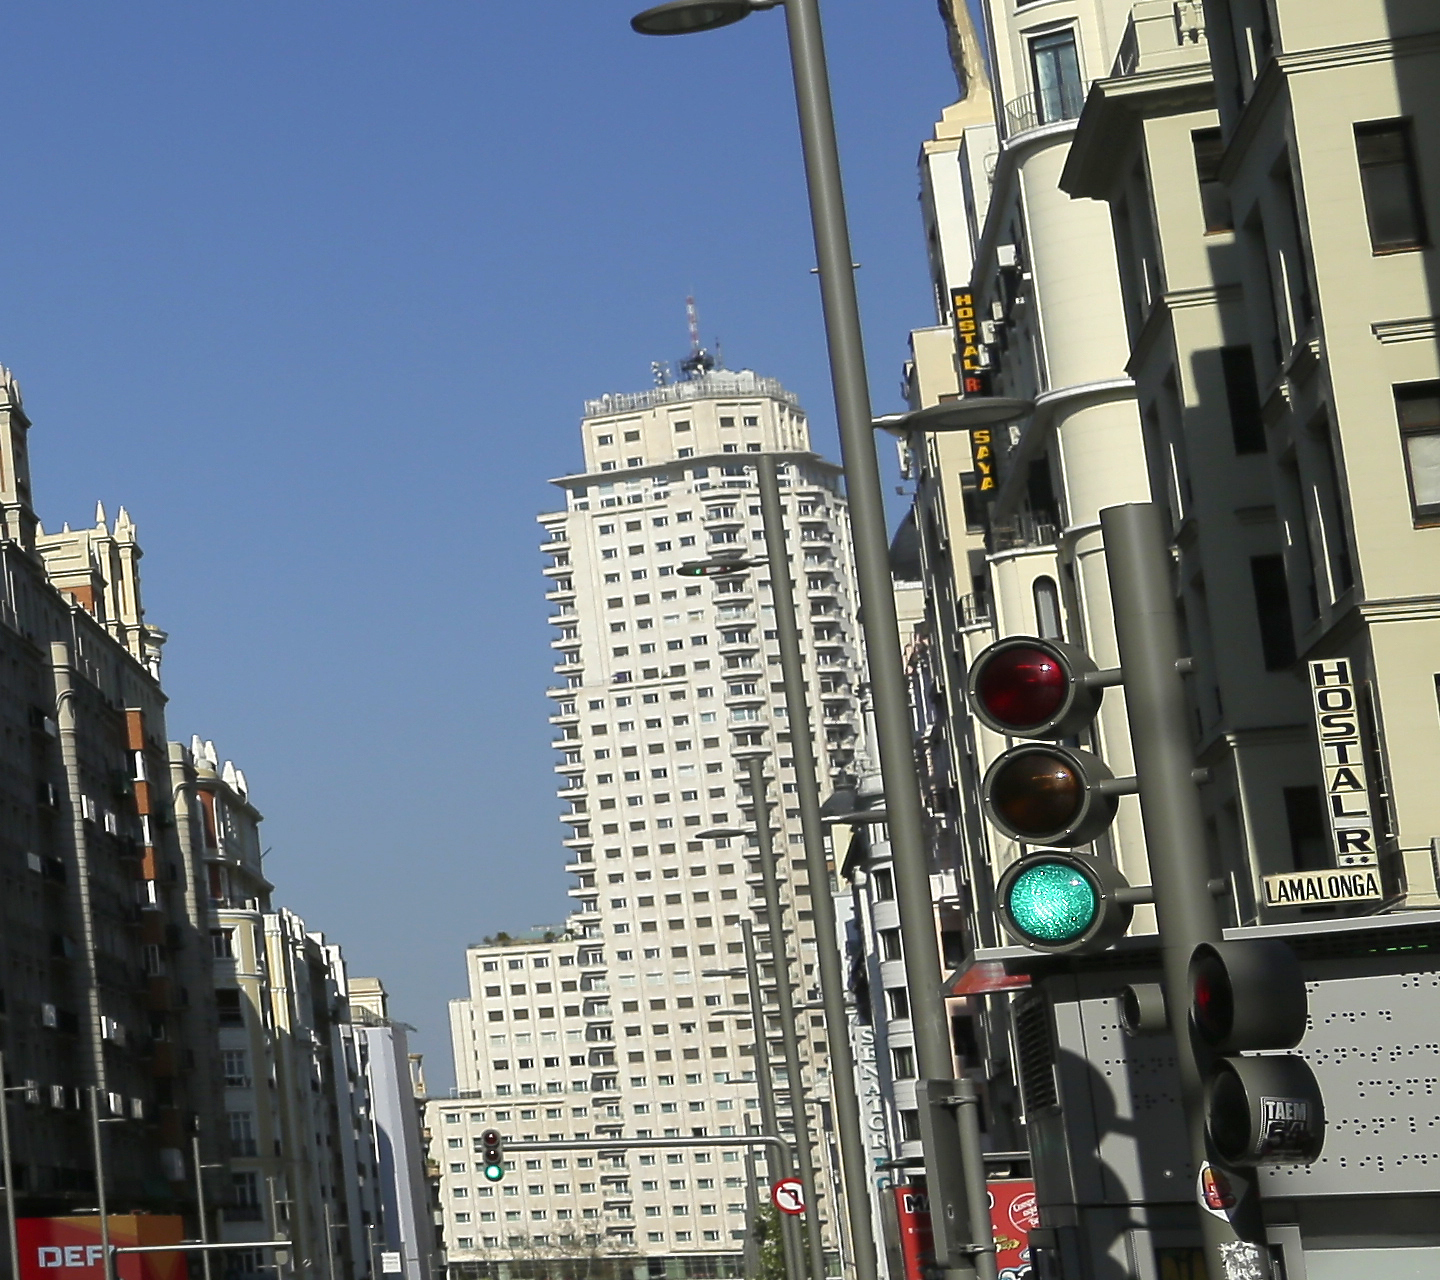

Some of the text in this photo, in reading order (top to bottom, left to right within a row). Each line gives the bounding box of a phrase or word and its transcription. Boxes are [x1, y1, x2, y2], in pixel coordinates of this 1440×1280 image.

[955, 293, 980, 371] HOSTAL
[1313, 660, 1368, 818] HOSTAL
[1337, 828, 1376, 854] R
[1265, 872, 1380, 904] LAMALONGA
[37, 1244, 116, 1268] DEF
